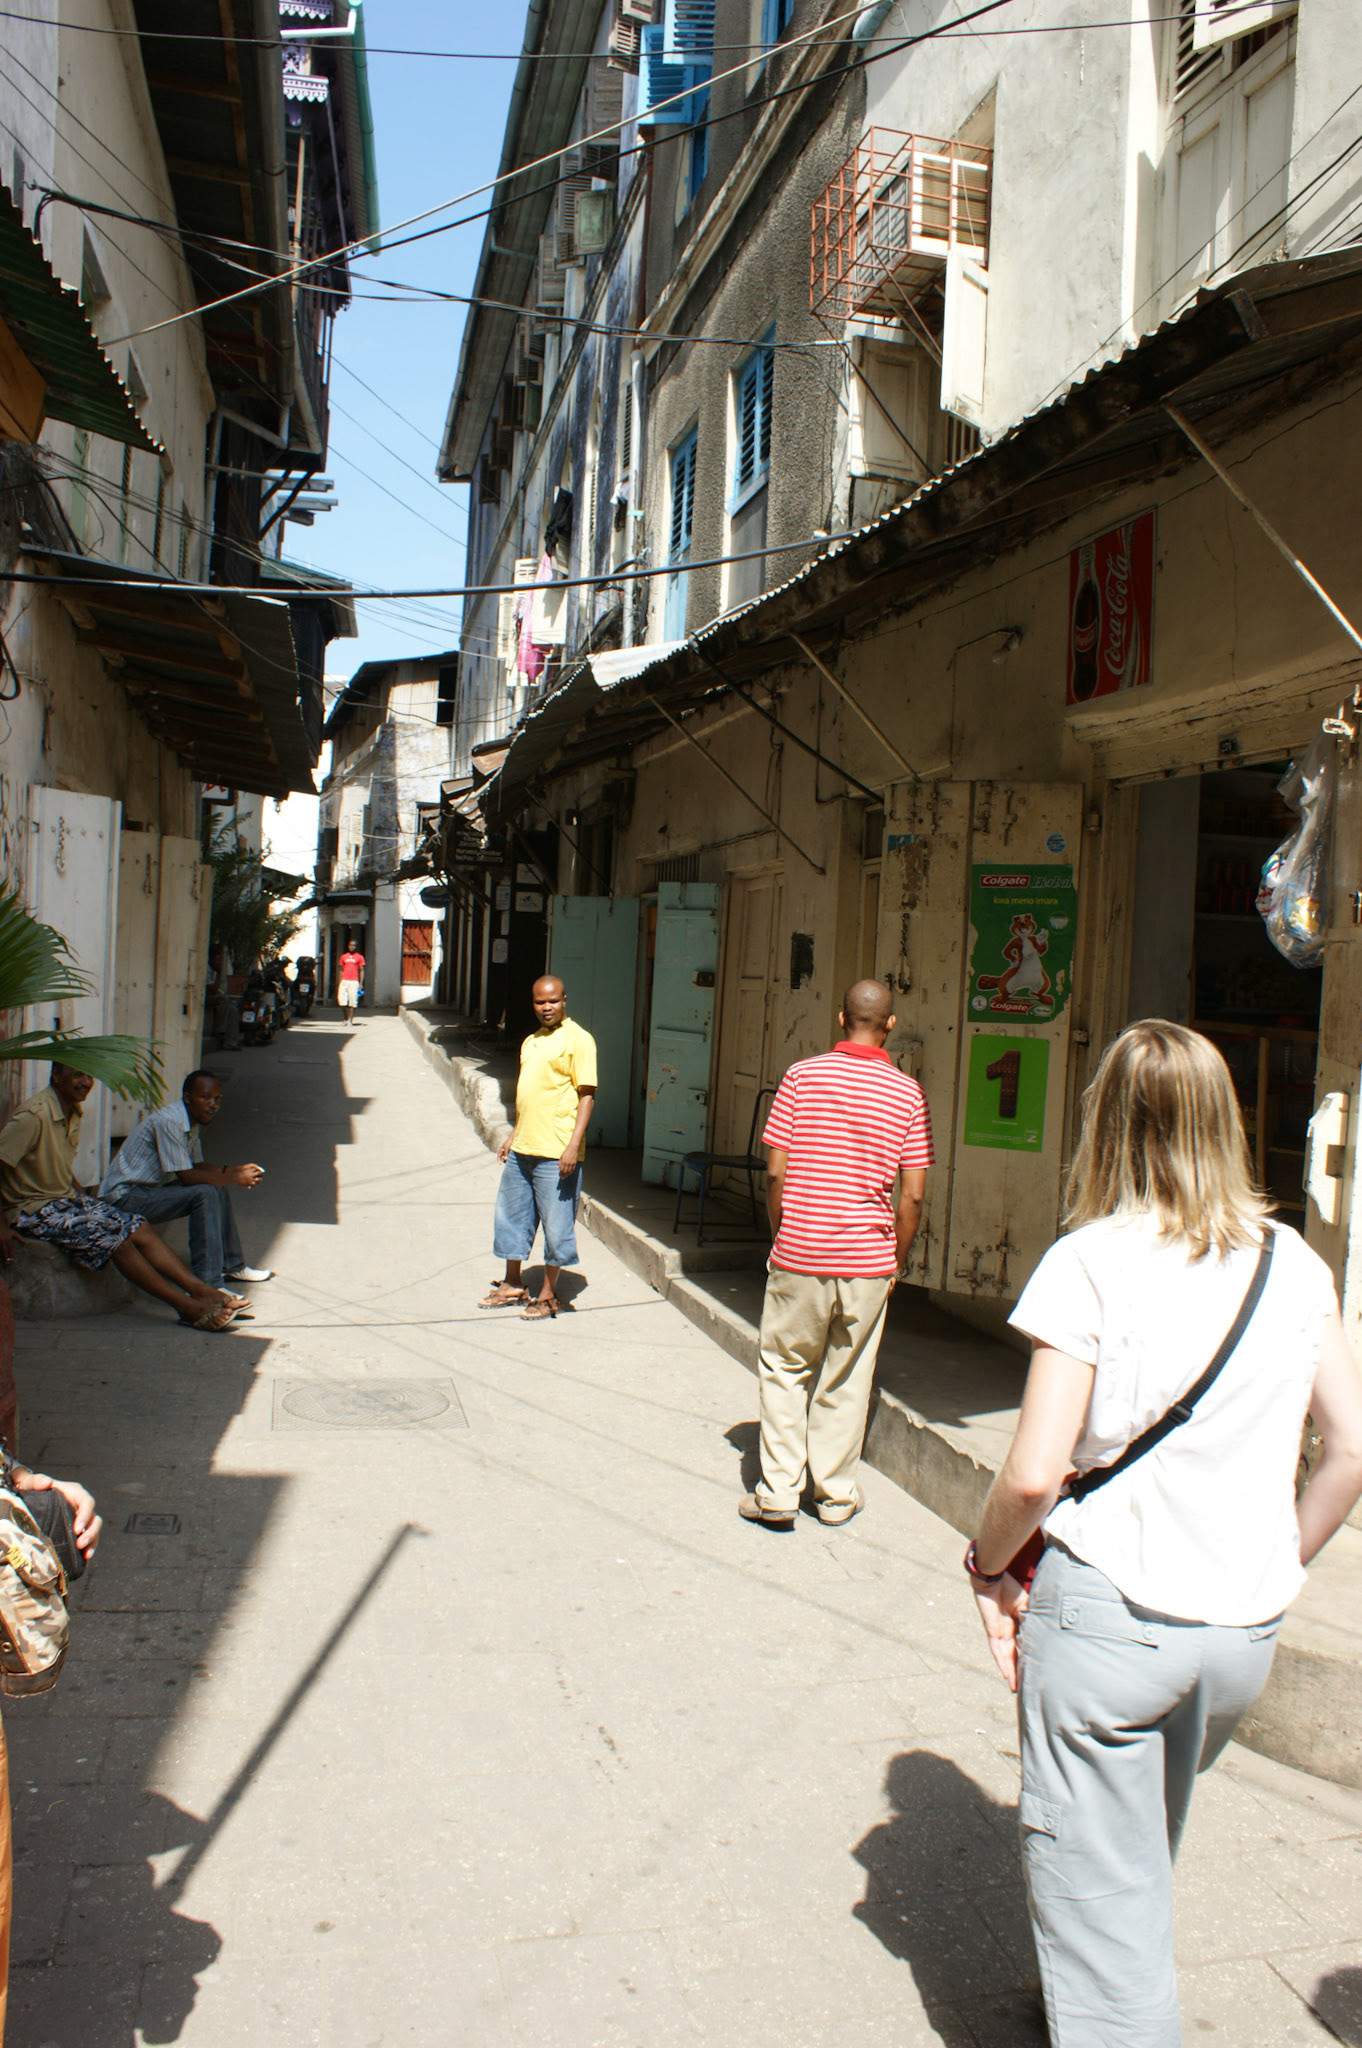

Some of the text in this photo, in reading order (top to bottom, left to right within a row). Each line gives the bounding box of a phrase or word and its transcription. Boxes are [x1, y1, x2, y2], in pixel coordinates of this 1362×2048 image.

[982, 876, 1027, 887] Colgate
[994, 897, 1010, 905] kwa
[1035, 897, 1059, 905] imara
[990, 1002, 1028, 1012] Colgate
[986, 1050, 1021, 1119] 1
